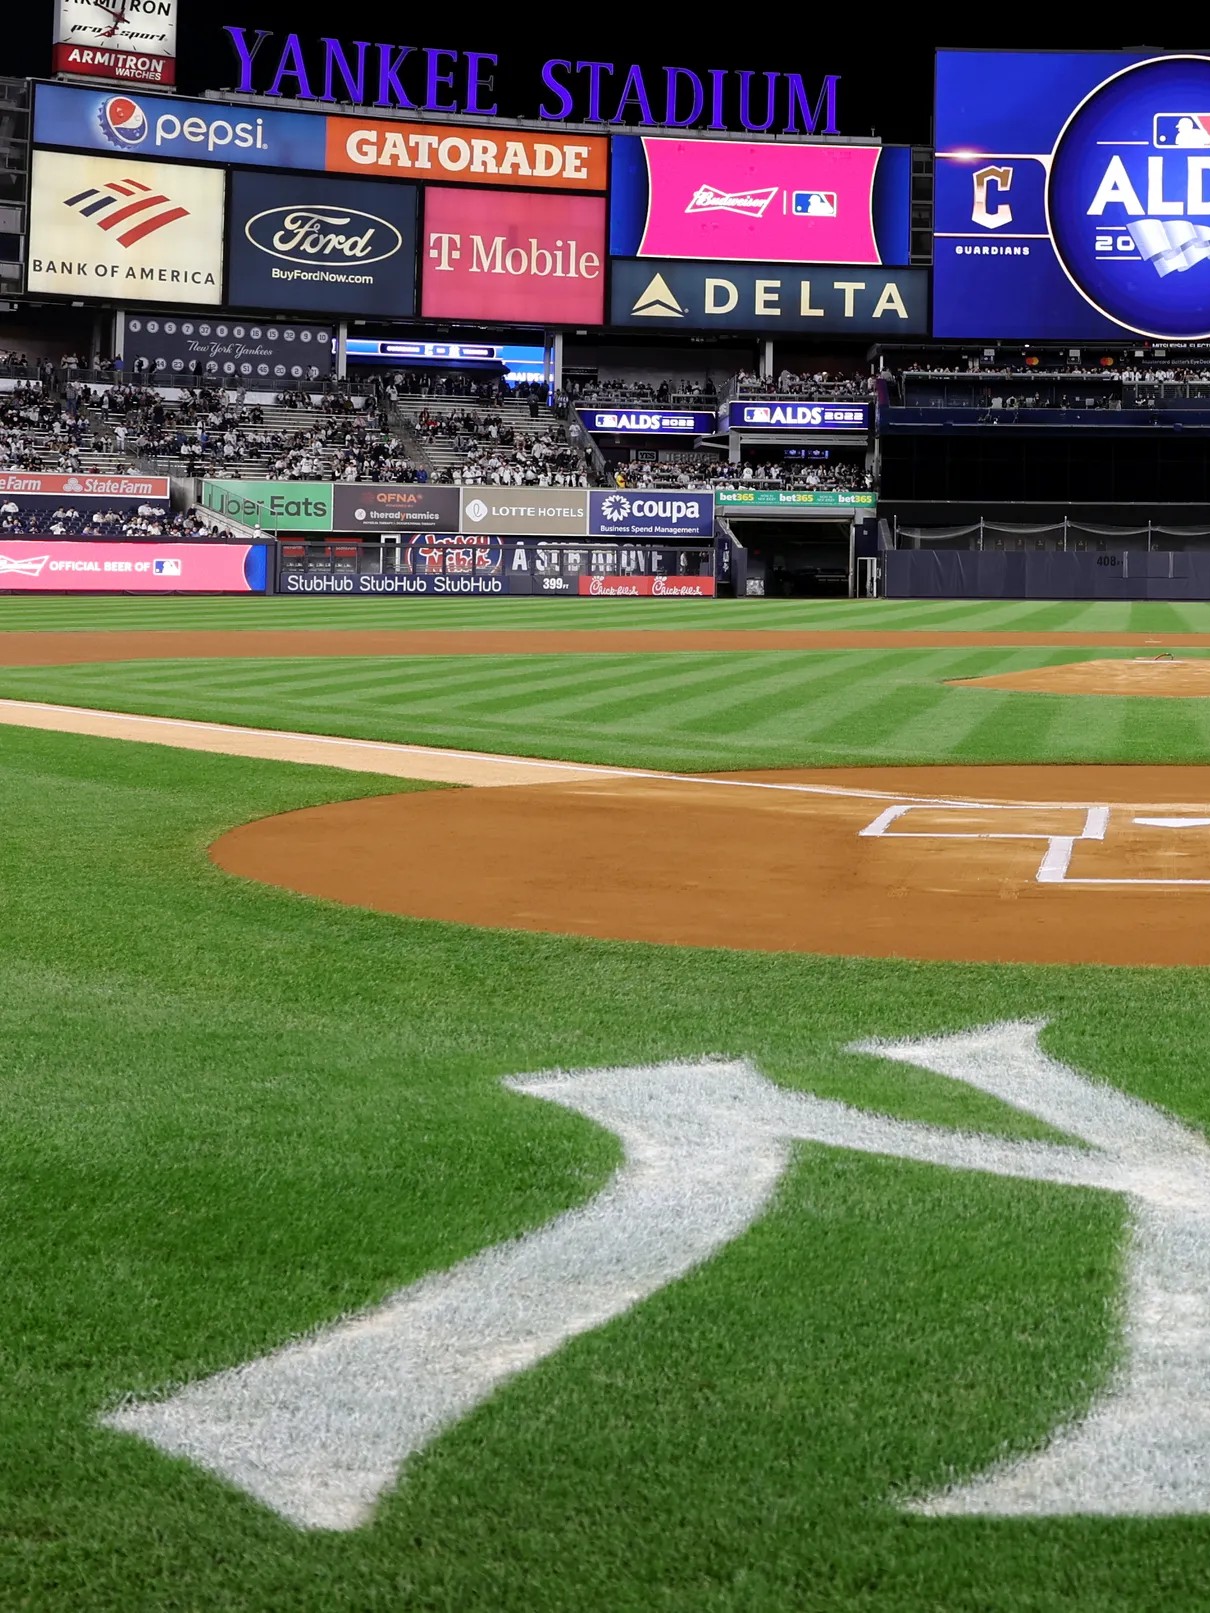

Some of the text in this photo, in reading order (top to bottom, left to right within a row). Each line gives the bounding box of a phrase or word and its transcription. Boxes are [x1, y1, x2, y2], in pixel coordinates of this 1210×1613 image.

[71, 24, 166, 41] pro sport
[68, 48, 163, 72] ARMITRON
[115, 67, 161, 81] WATCHES
[223, 26, 842, 135] YANKEE STADIUM
[156, 112, 264, 151] pepsi
[345, 130, 589, 179] GATORADE
[272, 212, 376, 257] Ford
[955, 245, 1030, 256] GUARDIANS
[32, 259, 216, 285] BANK OF AMERICA
[271, 268, 373, 285] BuyFordNow.com
[704, 278, 909, 319] DELTA
[187, 340, 273, 359] New York Yankees
[618, 415, 694, 429] ALDS 2022
[770, 407, 863, 424] ALDS 2022
[208, 493, 327, 517] Uber Eats
[719, 493, 754, 501] bet365
[779, 493, 814, 502] bet365
[838, 494, 872, 503] bet365
[370, 511, 440, 521] theradynamics
[492, 506, 584, 517] LOTTE HOTELS
[632, 500, 700, 523] coupa
[600, 525, 700, 534] Business Spend Management
[512, 542, 528, 571] A
[50, 561, 100, 572] OFFICIAL
[104, 561, 132, 572] BEER
[134, 561, 150, 572] OF
[287, 575, 502, 592] StubHub StubHub StubHub
